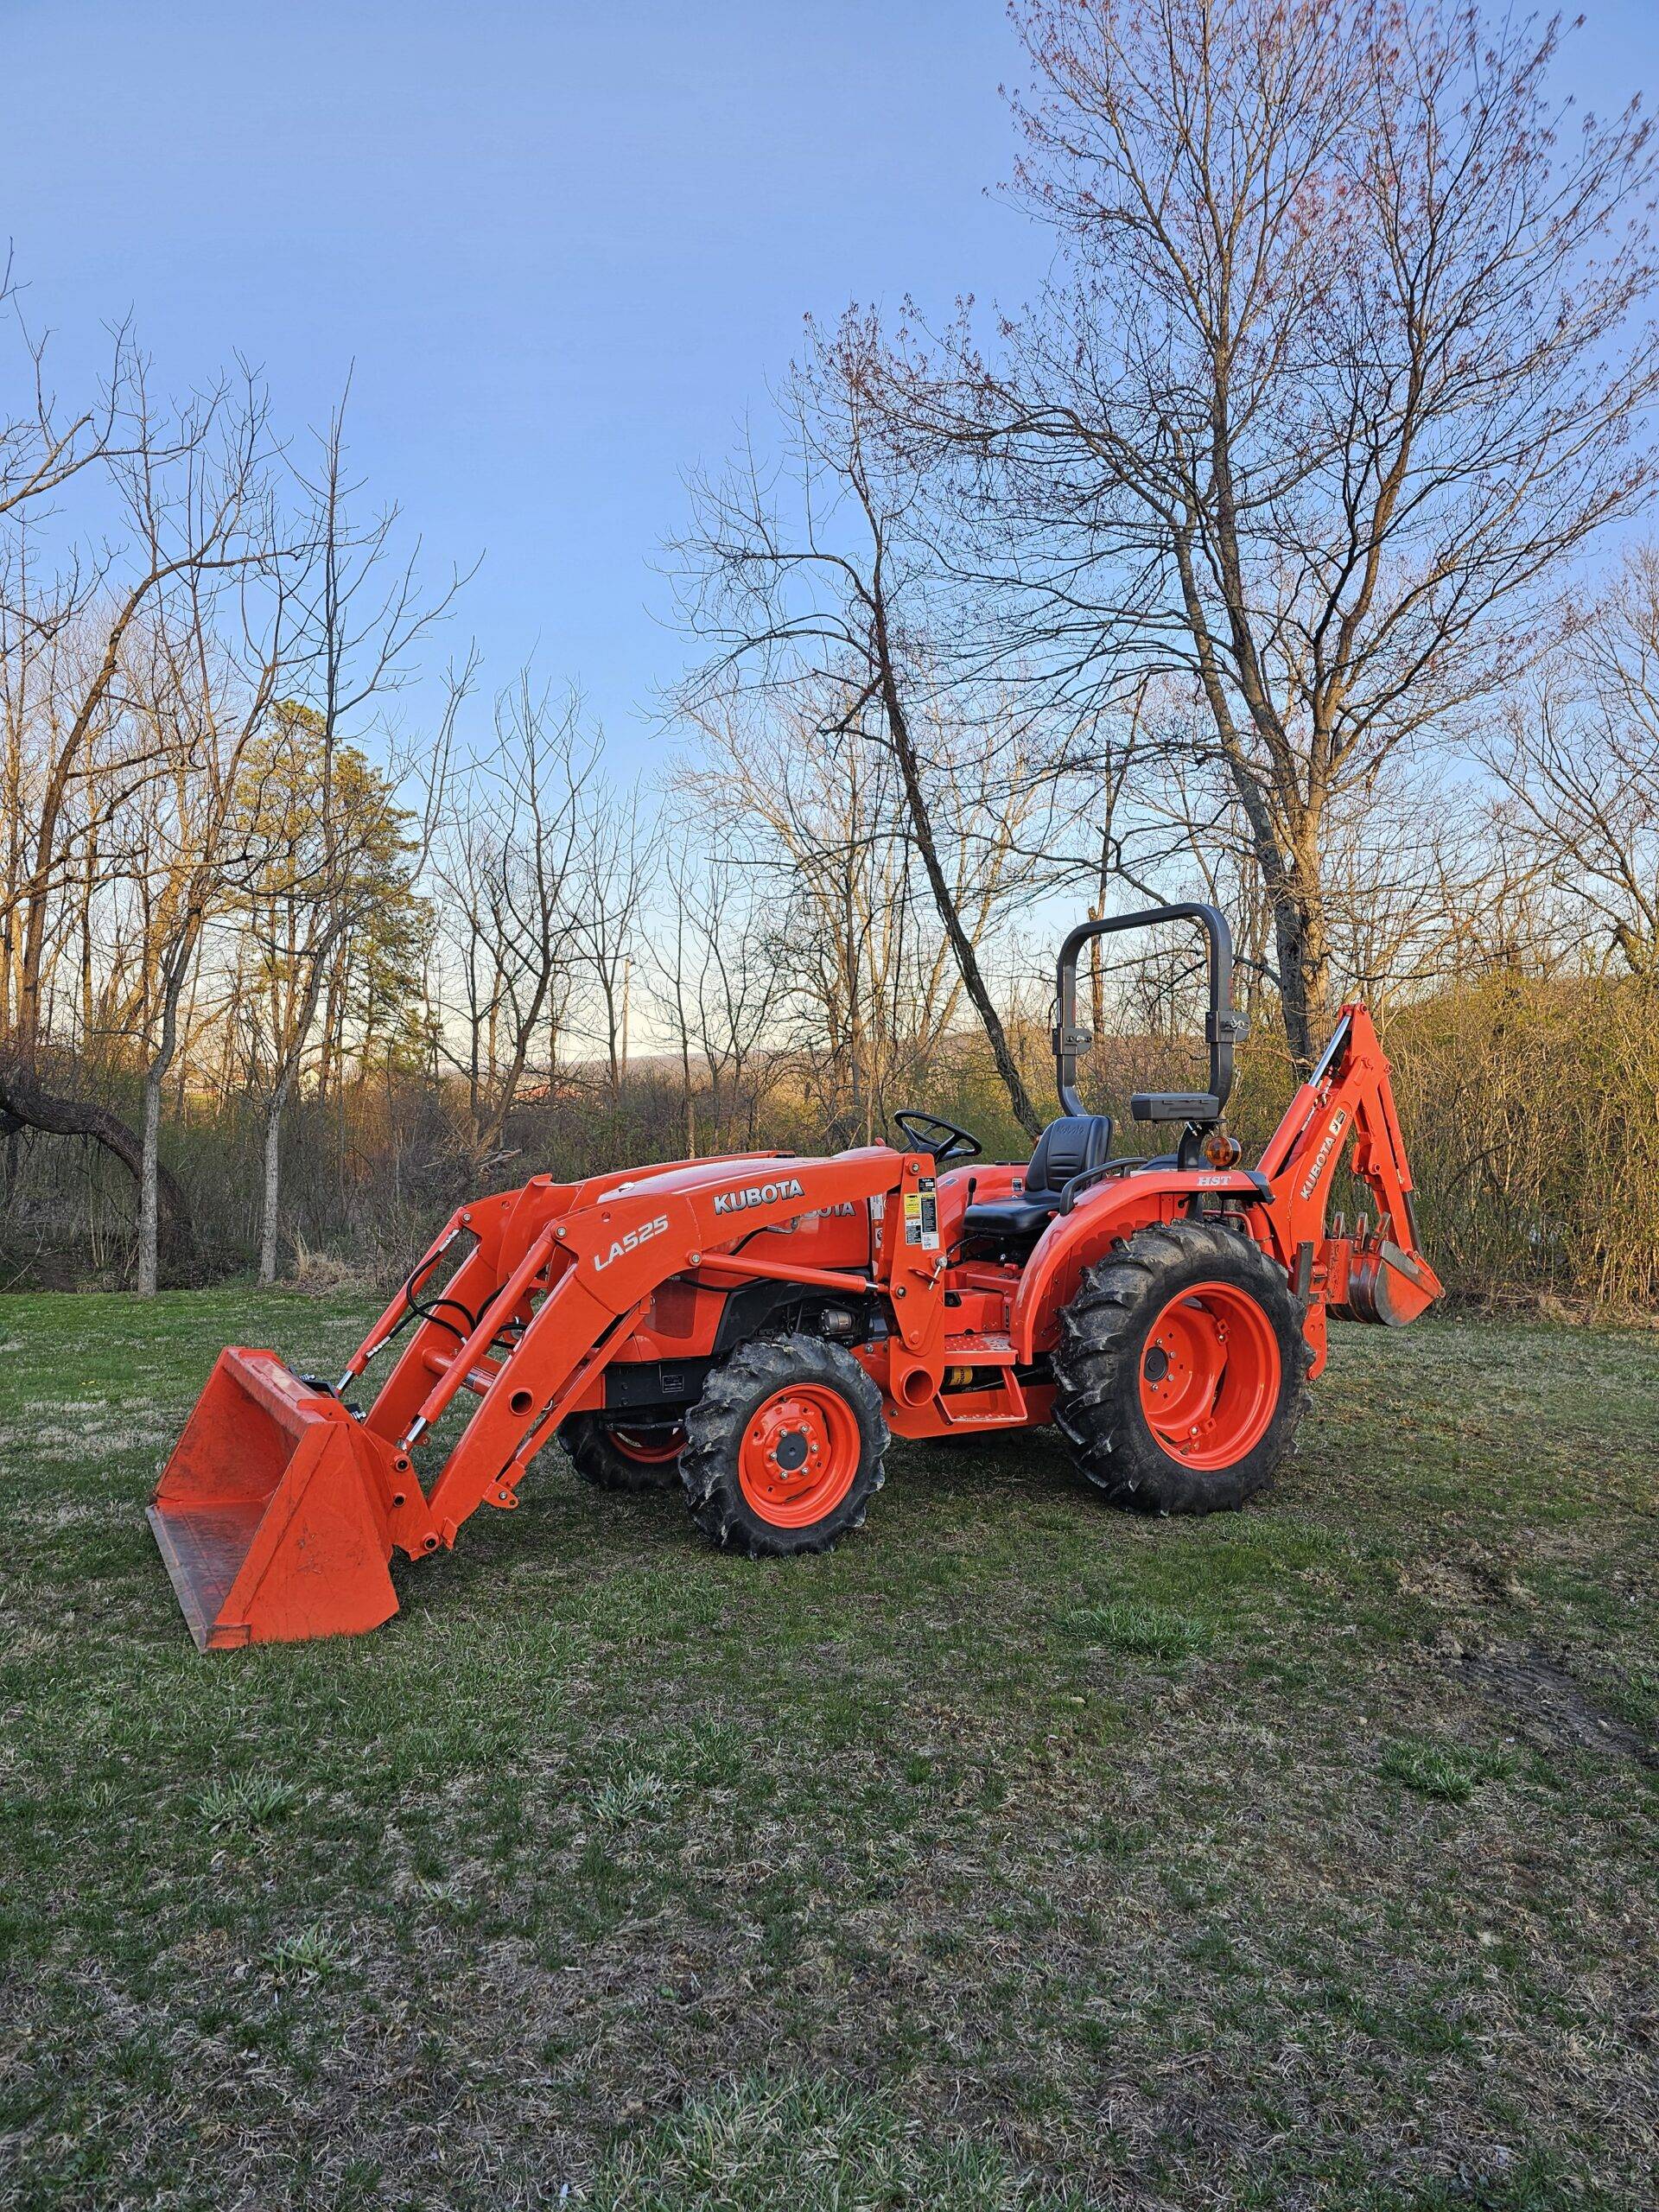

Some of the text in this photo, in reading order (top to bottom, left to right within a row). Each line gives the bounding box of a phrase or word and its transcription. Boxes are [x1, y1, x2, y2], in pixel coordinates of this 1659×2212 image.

[1197, 1176, 1231, 1186] HST
[1300, 1136, 1336, 1201] KUBOTA
[713, 1179, 805, 1215] KUBOTA
[594, 1213, 669, 1272] LA525
